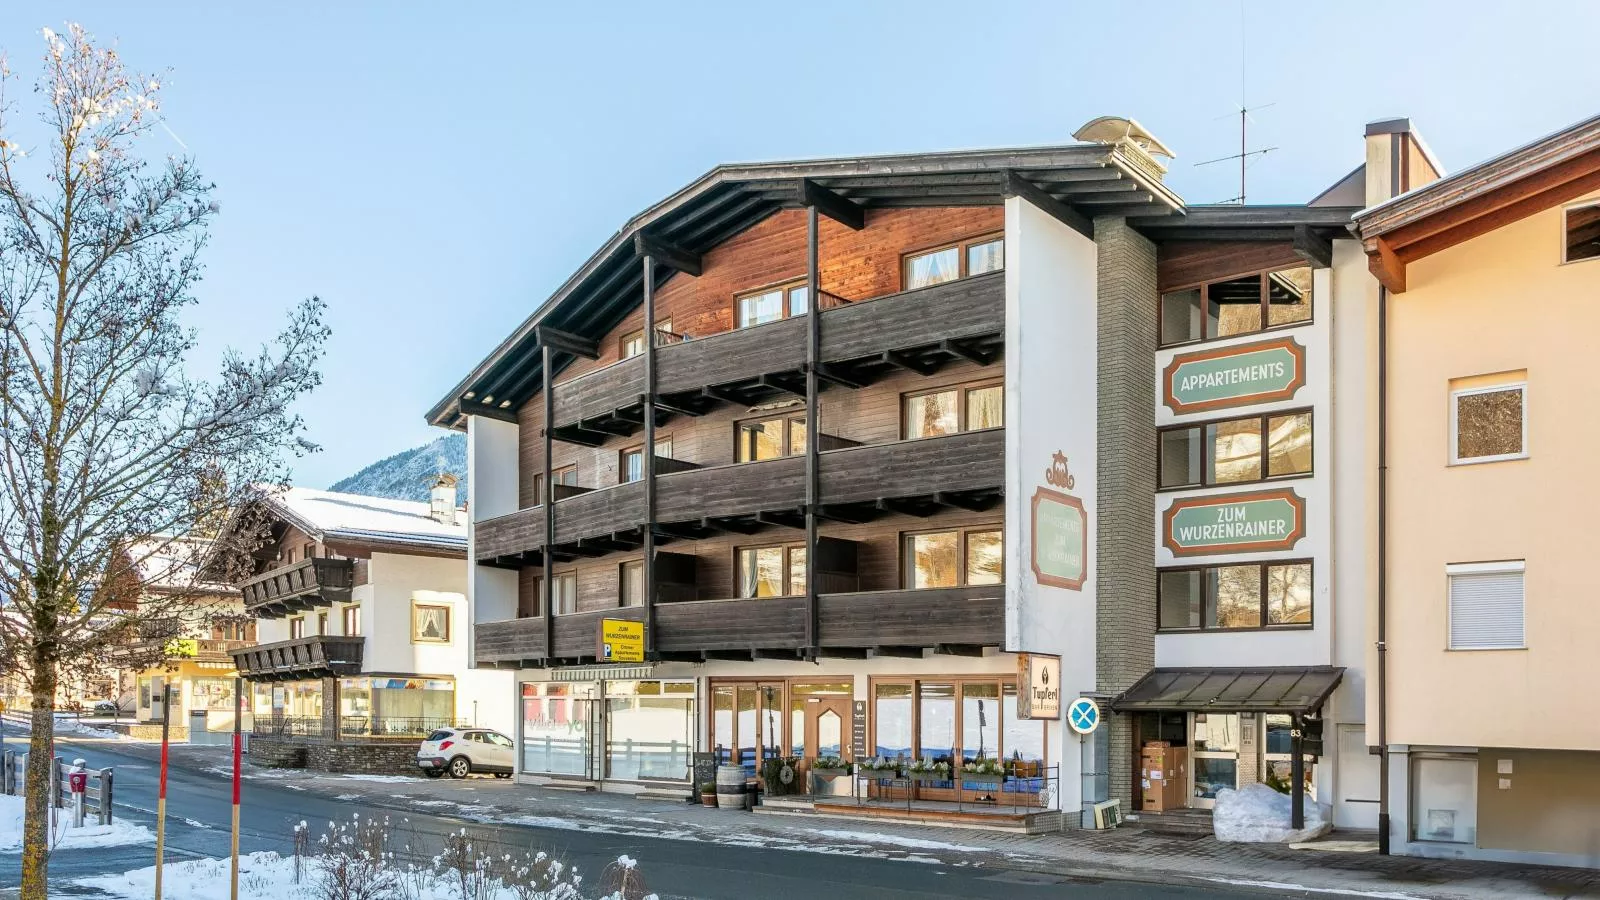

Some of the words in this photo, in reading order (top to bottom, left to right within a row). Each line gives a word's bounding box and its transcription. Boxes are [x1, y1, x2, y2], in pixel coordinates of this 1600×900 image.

[1180, 361, 1285, 392] APPARTEMENTS
[1217, 506, 1246, 523] ZUM
[1179, 519, 1286, 541] WURZENRAINER
[604, 644, 611, 656] P
